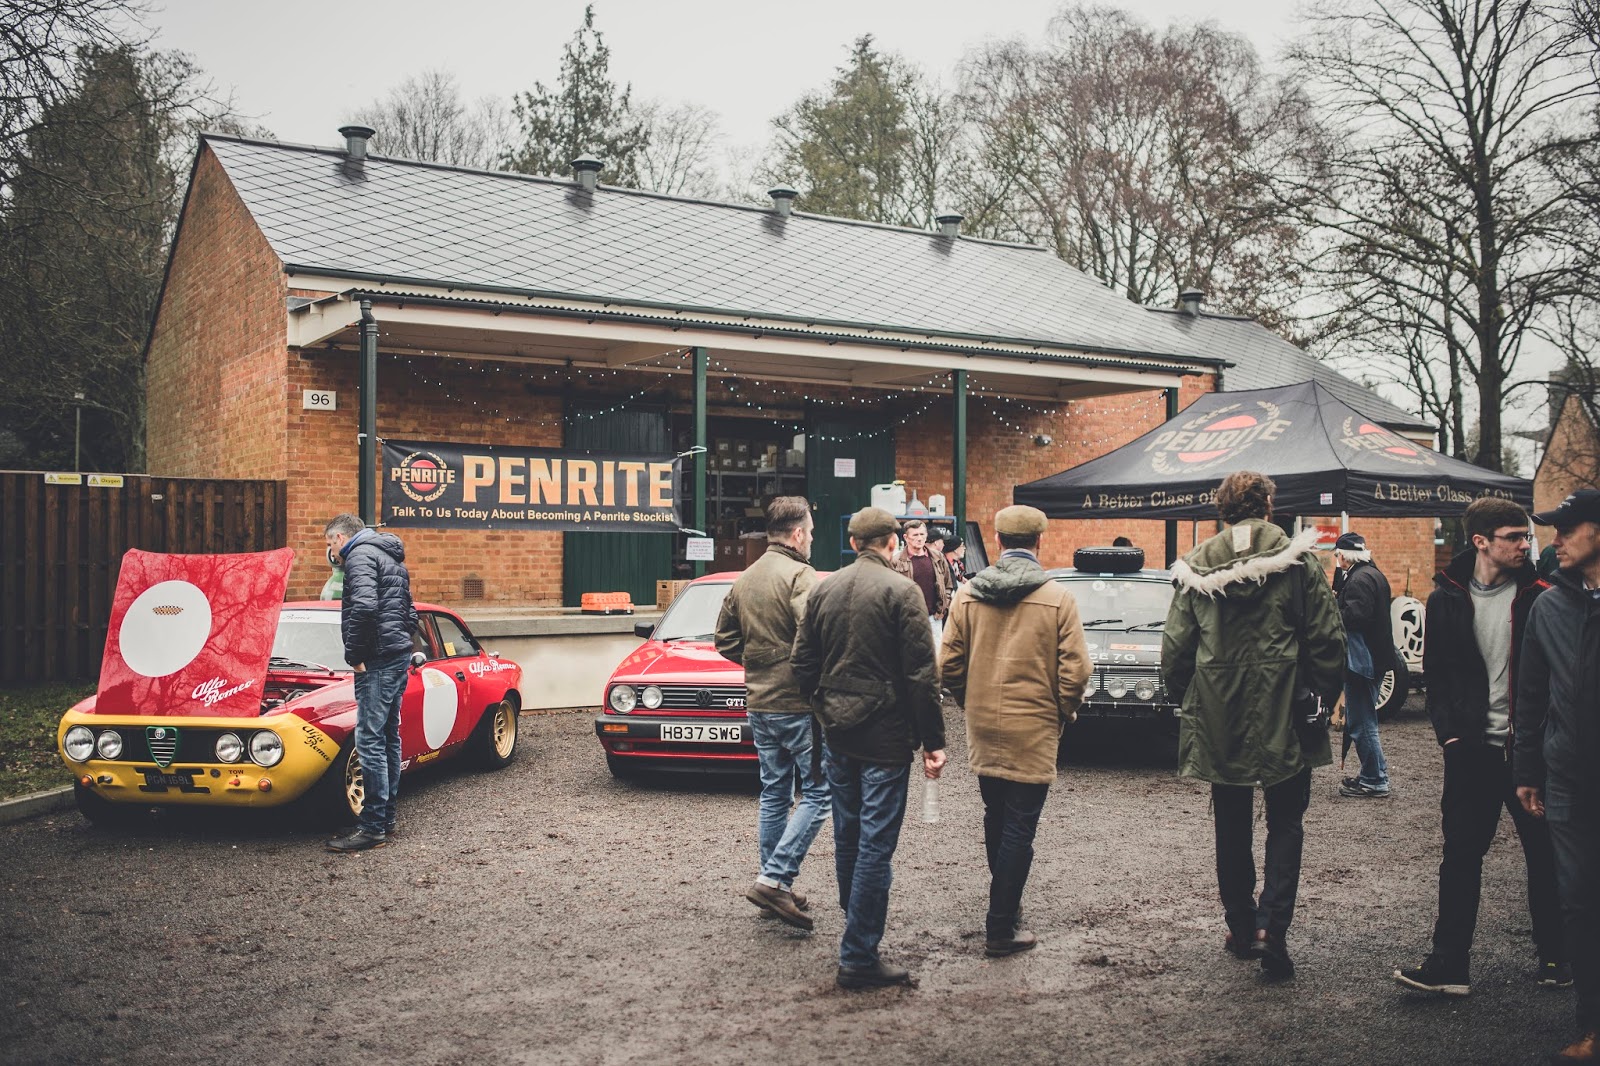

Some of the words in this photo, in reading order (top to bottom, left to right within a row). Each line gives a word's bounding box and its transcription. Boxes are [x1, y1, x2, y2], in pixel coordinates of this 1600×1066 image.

[311, 393, 330, 405] 96
[1144, 419, 1292, 452] PENRITE
[391, 467, 455, 485] PENRITE
[462, 455, 673, 508] PENRITE
[1082, 494, 1093, 508] A
[1098, 493, 1144, 508] Better
[1150, 491, 1194, 507] Class
[1375, 485, 1386, 500] A
[1389, 484, 1432, 502] Better
[1437, 485, 1473, 503] Class
[392, 506, 415, 517] Talk
[419, 507, 433, 518] To
[437, 507, 452, 518] Us
[455, 508, 489, 521] Today
[491, 509, 525, 520] About
[527, 509, 581, 523] Becoming
[583, 511, 592, 521] A
[594, 511, 631, 522] Penrite
[633, 512, 674, 522] Stockist
[1088, 652, 1109, 660] CE
[1112, 653, 1136, 662] 7G
[469, 660, 492, 678] Alfa
[489, 659, 516, 672] Romeo
[191, 676, 228, 699] Alfa
[200, 679, 254, 707] Romeo
[726, 697, 745, 707] GTI
[302, 725, 325, 744] Alfa
[663, 726, 704, 740] H837
[708, 727, 740, 740] SWG
[303, 734, 332, 761] Romeo
[146, 774, 167, 784] PGN
[170, 775, 190, 785] 169L
